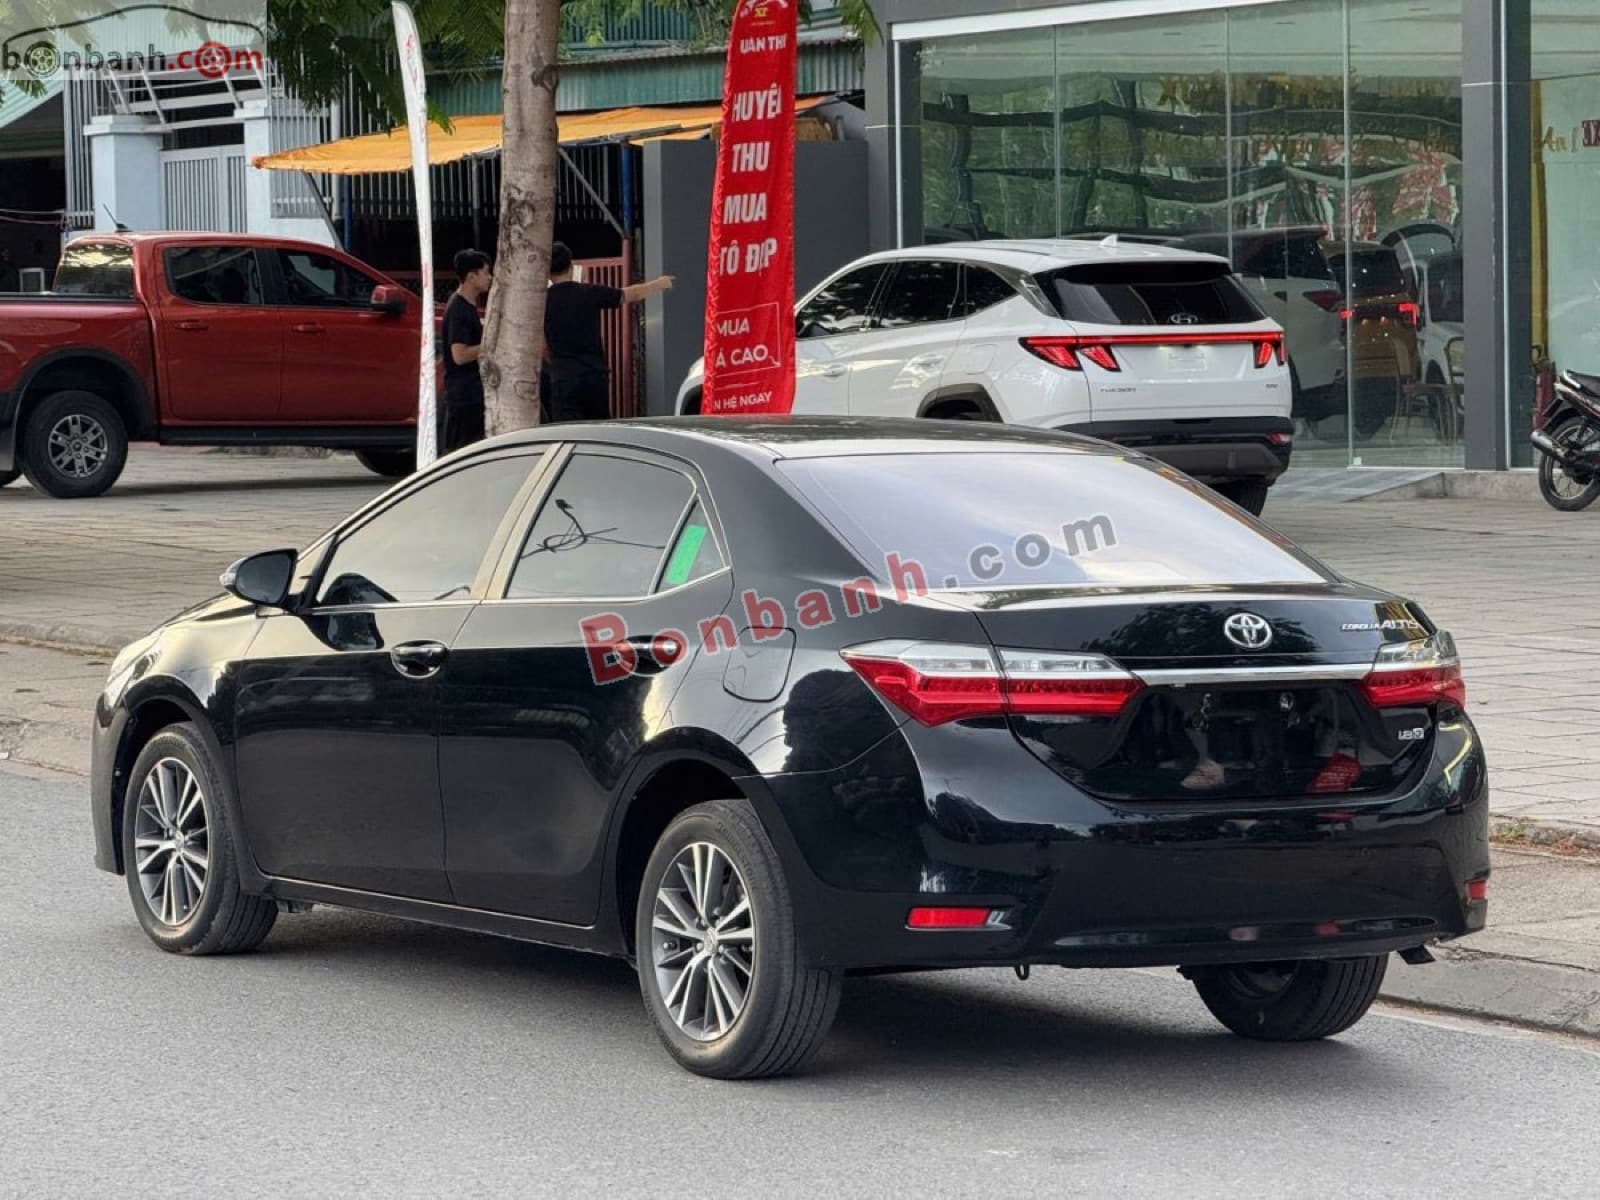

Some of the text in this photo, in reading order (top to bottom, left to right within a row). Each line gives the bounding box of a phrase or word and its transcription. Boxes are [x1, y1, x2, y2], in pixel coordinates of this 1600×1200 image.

[731, 141, 771, 173] THU
[723, 192, 767, 225] MUA
[730, 343, 769, 366] CAO
[739, 390, 773, 407] NGAY
